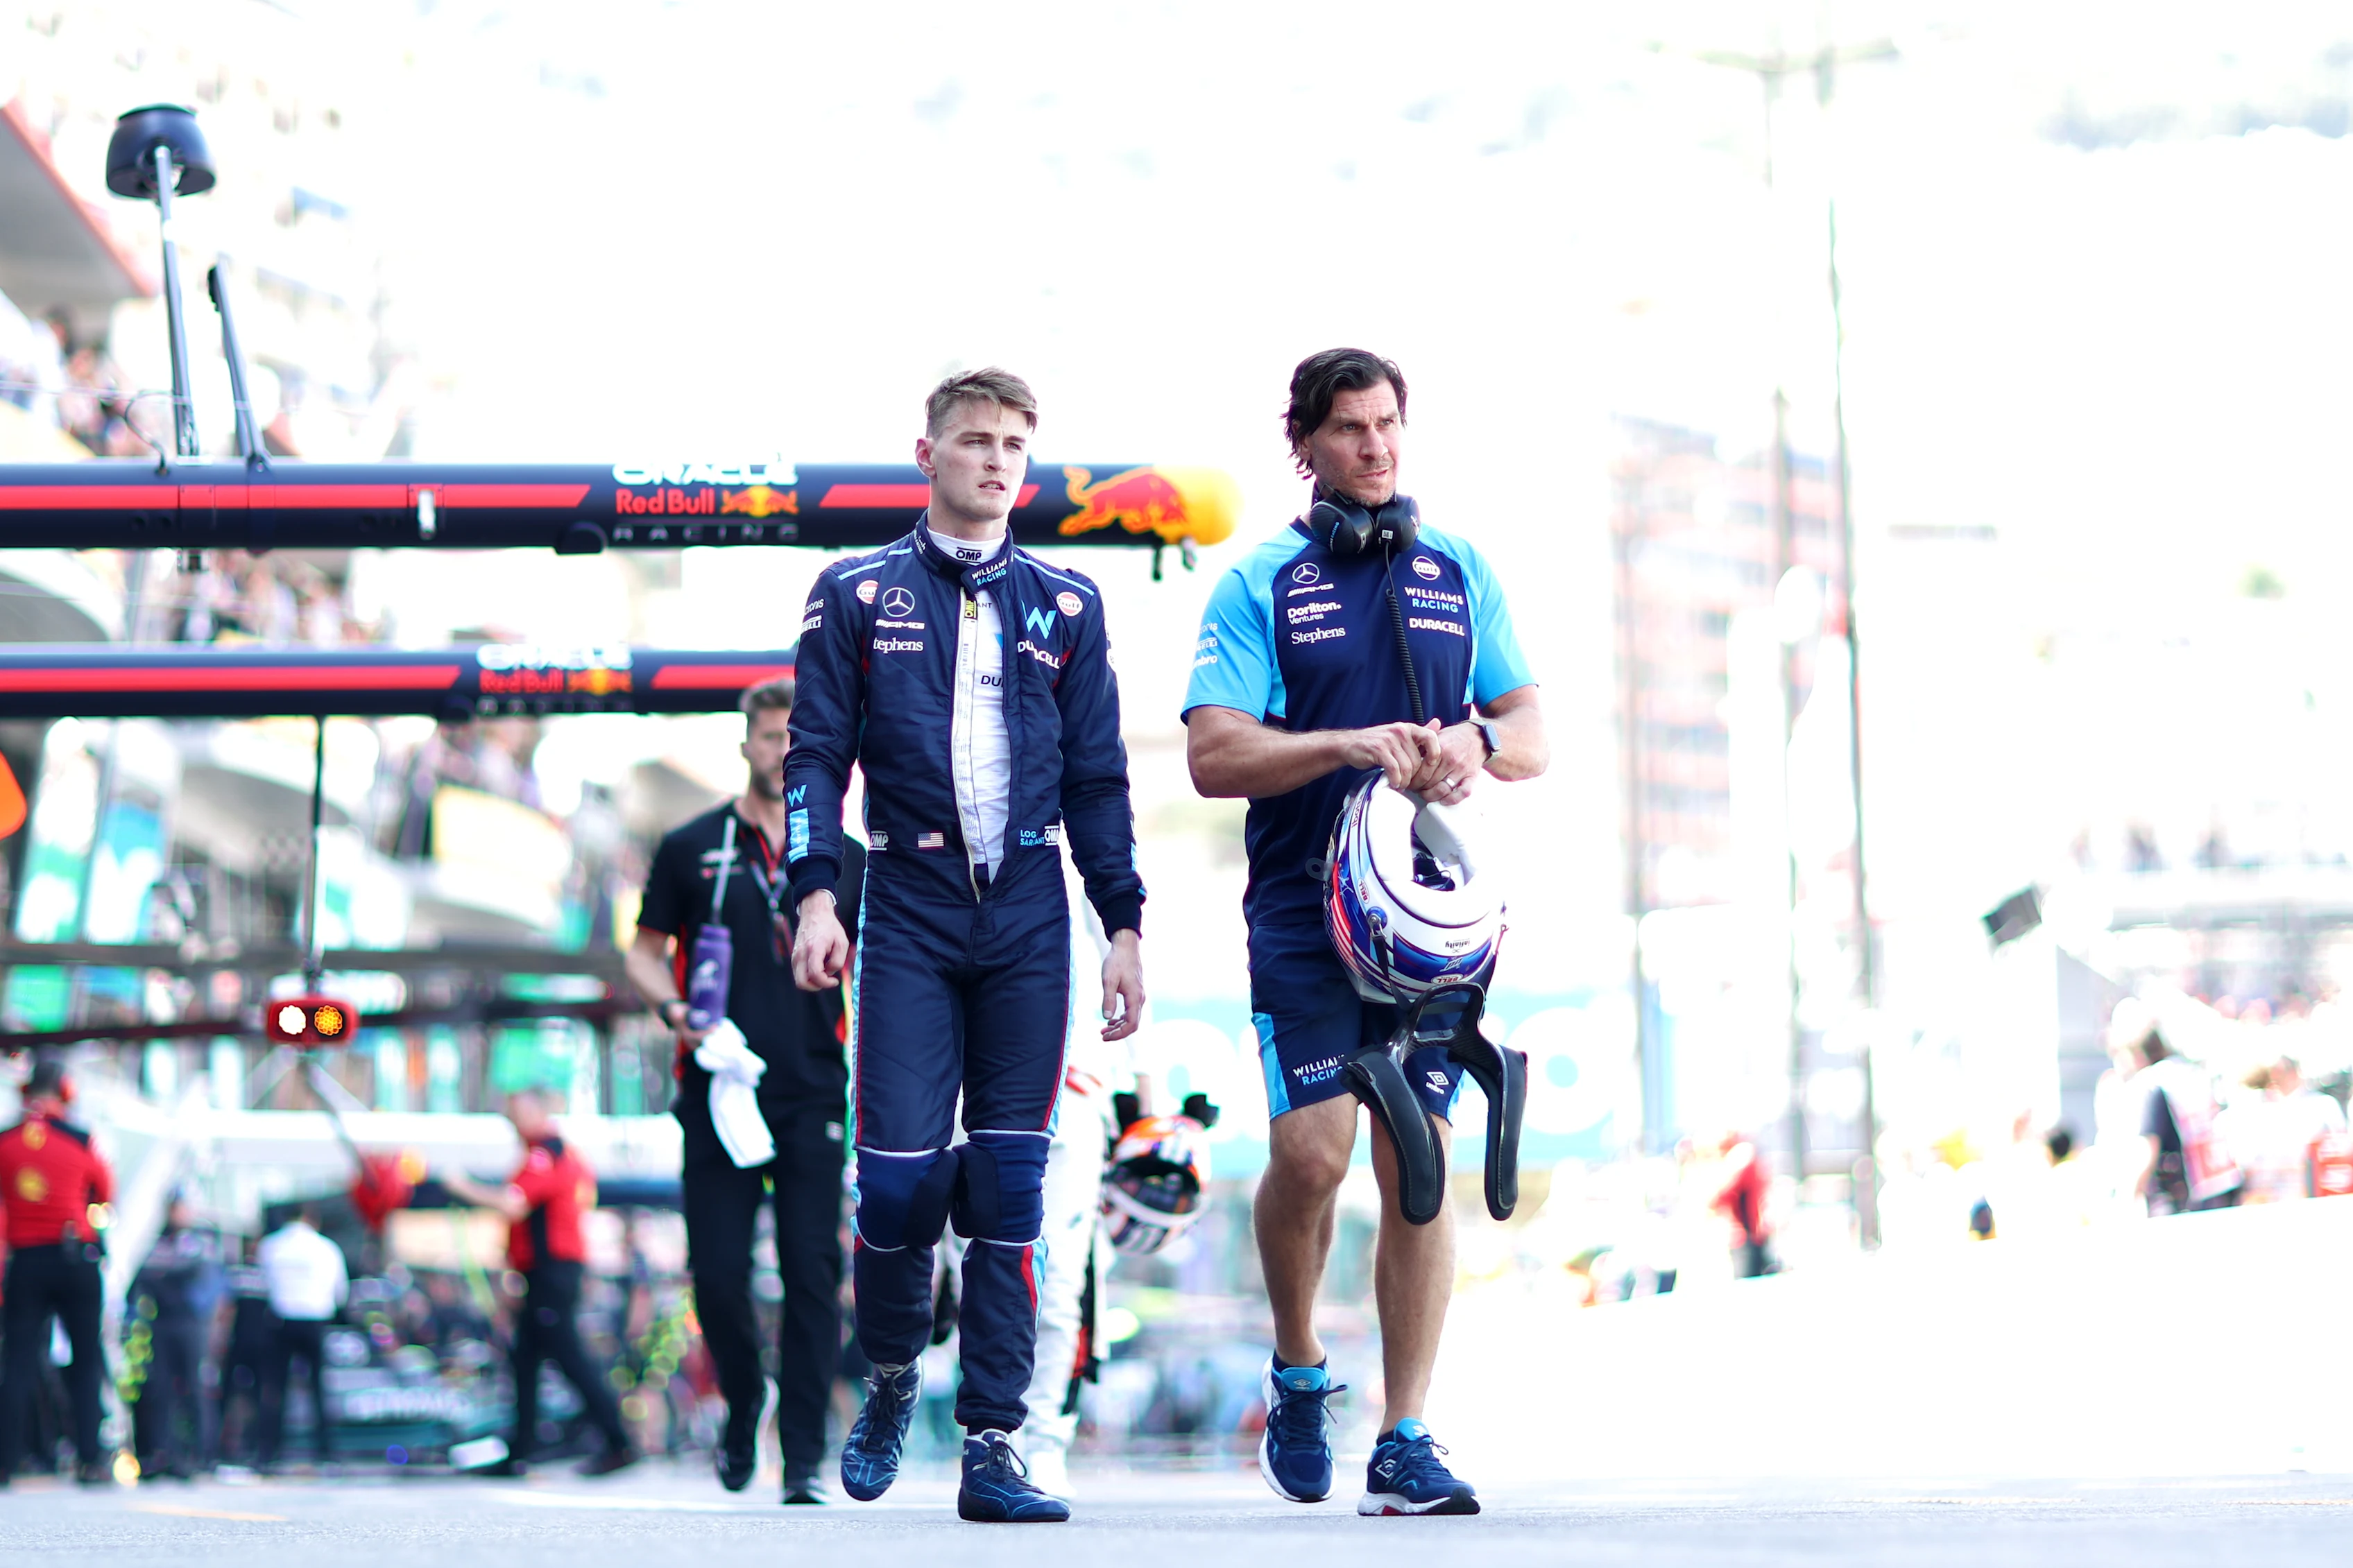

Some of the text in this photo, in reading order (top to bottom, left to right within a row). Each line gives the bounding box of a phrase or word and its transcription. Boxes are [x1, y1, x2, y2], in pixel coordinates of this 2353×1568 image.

[616, 488, 715, 515] Red Bull
[613, 525, 798, 541] RACING
[956, 549, 982, 561] OMP
[972, 558, 1008, 580] WILLIAMS
[976, 568, 1007, 586] RACING
[1058, 598, 1080, 610] Gulf
[1404, 587, 1464, 605] WILLIAMS
[965, 600, 974, 617] OMP
[1412, 598, 1458, 613] RACING
[1289, 613, 1324, 625] Ventures
[1409, 618, 1465, 636] DURACELL
[1291, 627, 1346, 644] Stephens
[873, 637, 923, 654] tephens
[479, 668, 564, 693] Red Bull
[870, 834, 889, 847] OMP
[1358, 881, 1369, 902] BELL
[1445, 940, 1470, 949] infinity
[1301, 1066, 1343, 1086] RACIN
[1426, 1082, 1445, 1094] umbro
